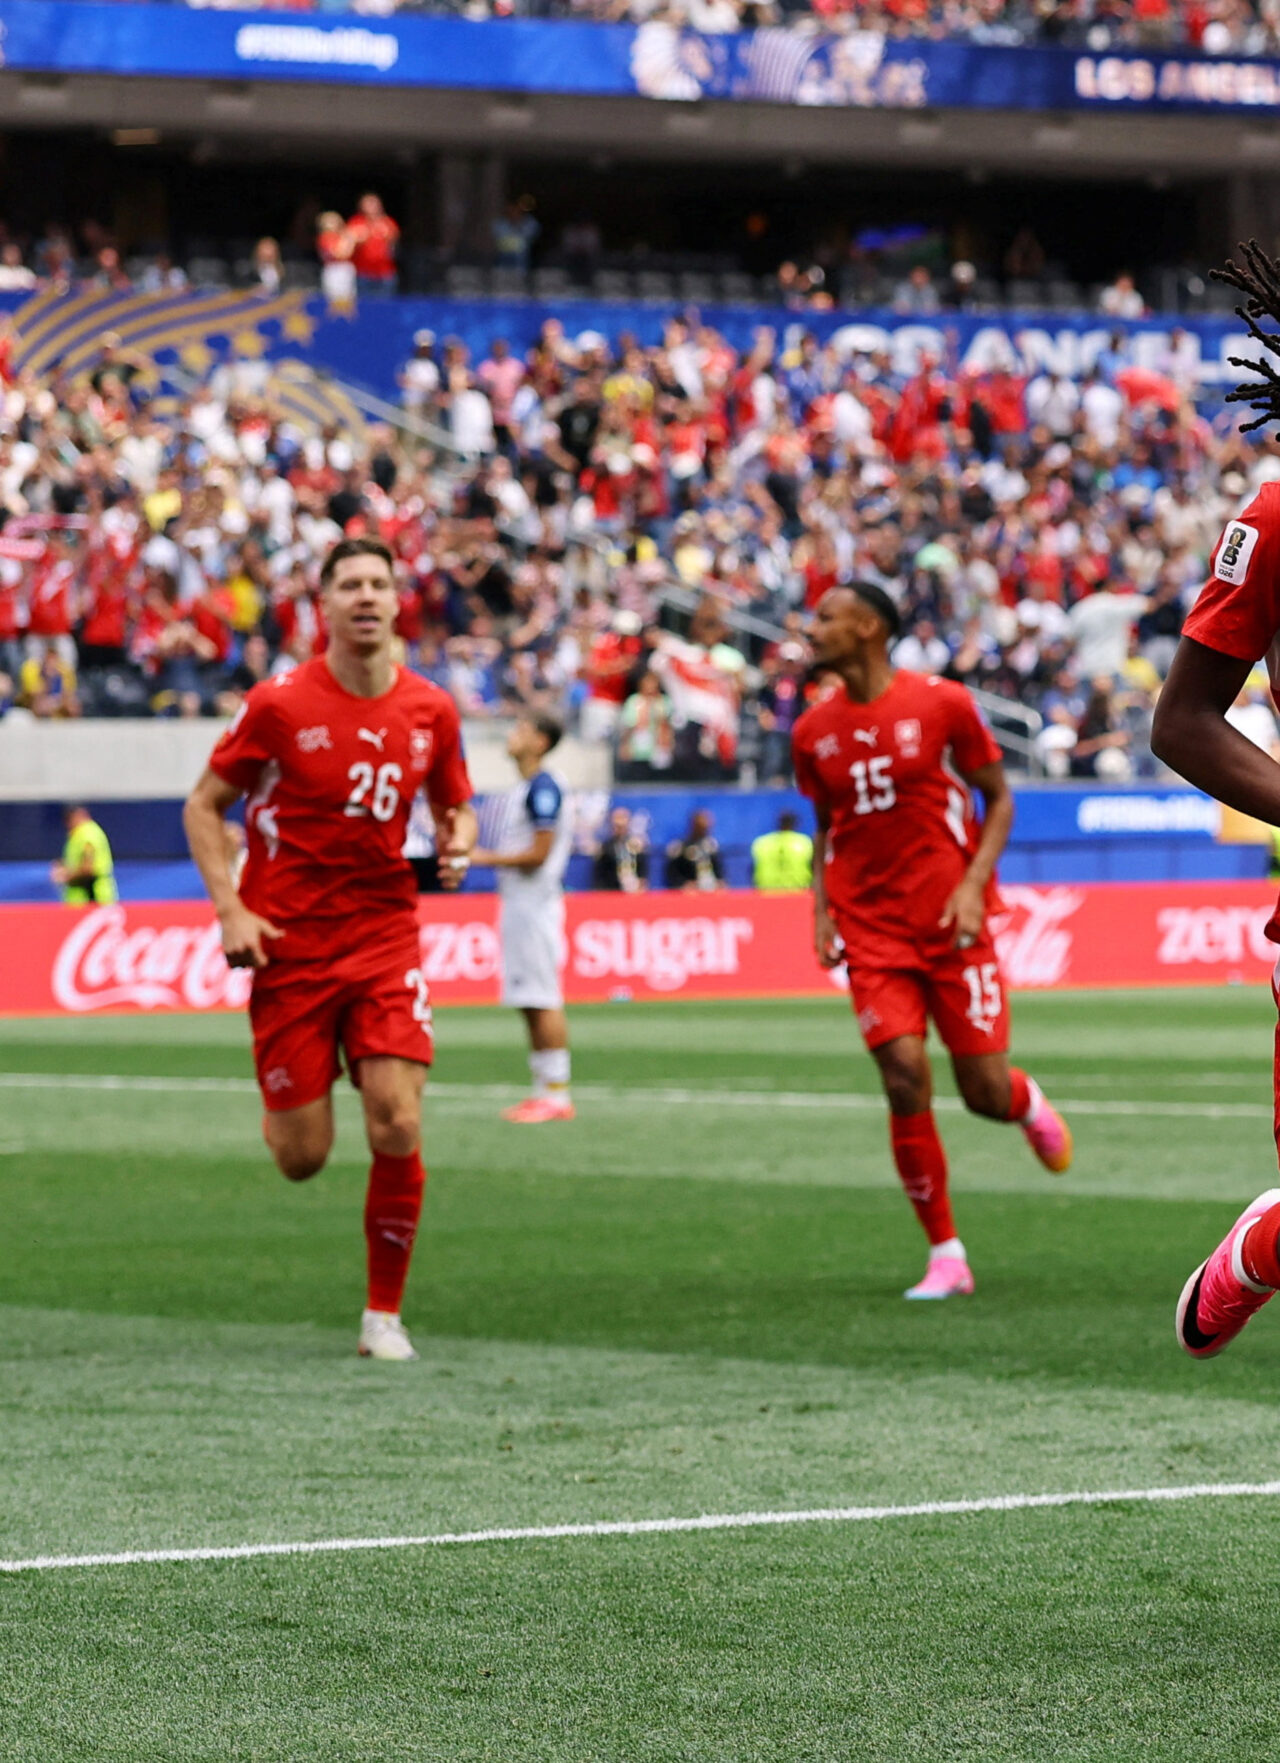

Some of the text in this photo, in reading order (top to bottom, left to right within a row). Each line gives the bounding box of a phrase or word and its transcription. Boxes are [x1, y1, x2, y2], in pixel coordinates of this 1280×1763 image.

[343, 761, 403, 822] 26
[849, 755, 897, 815] 15
[574, 917, 753, 991] sugar
[962, 963, 1002, 1019] 15
